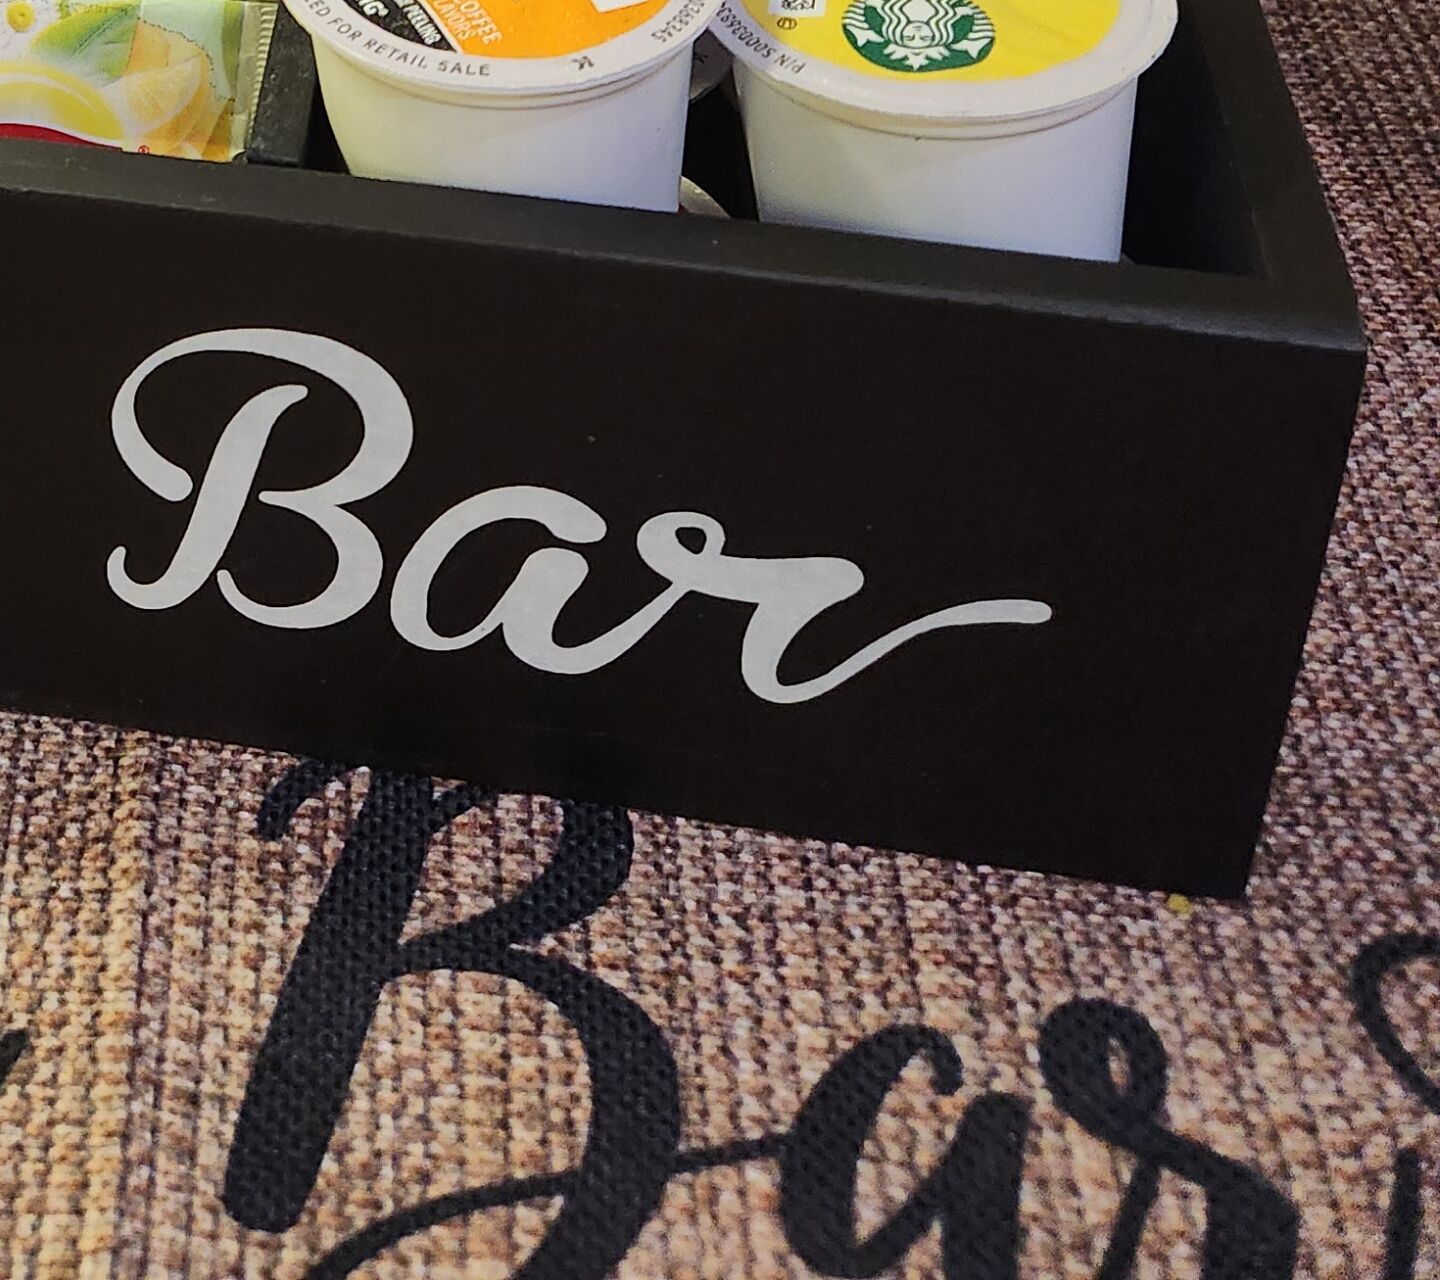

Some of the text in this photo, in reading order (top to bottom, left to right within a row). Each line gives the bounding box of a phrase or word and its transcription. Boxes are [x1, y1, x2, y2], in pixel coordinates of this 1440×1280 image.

[326, 16, 363, 42] FOR
[362, 38, 428, 70] RETAIL
[436, 59, 491, 77] SALE
[106, 328, 1053, 705] Bar
